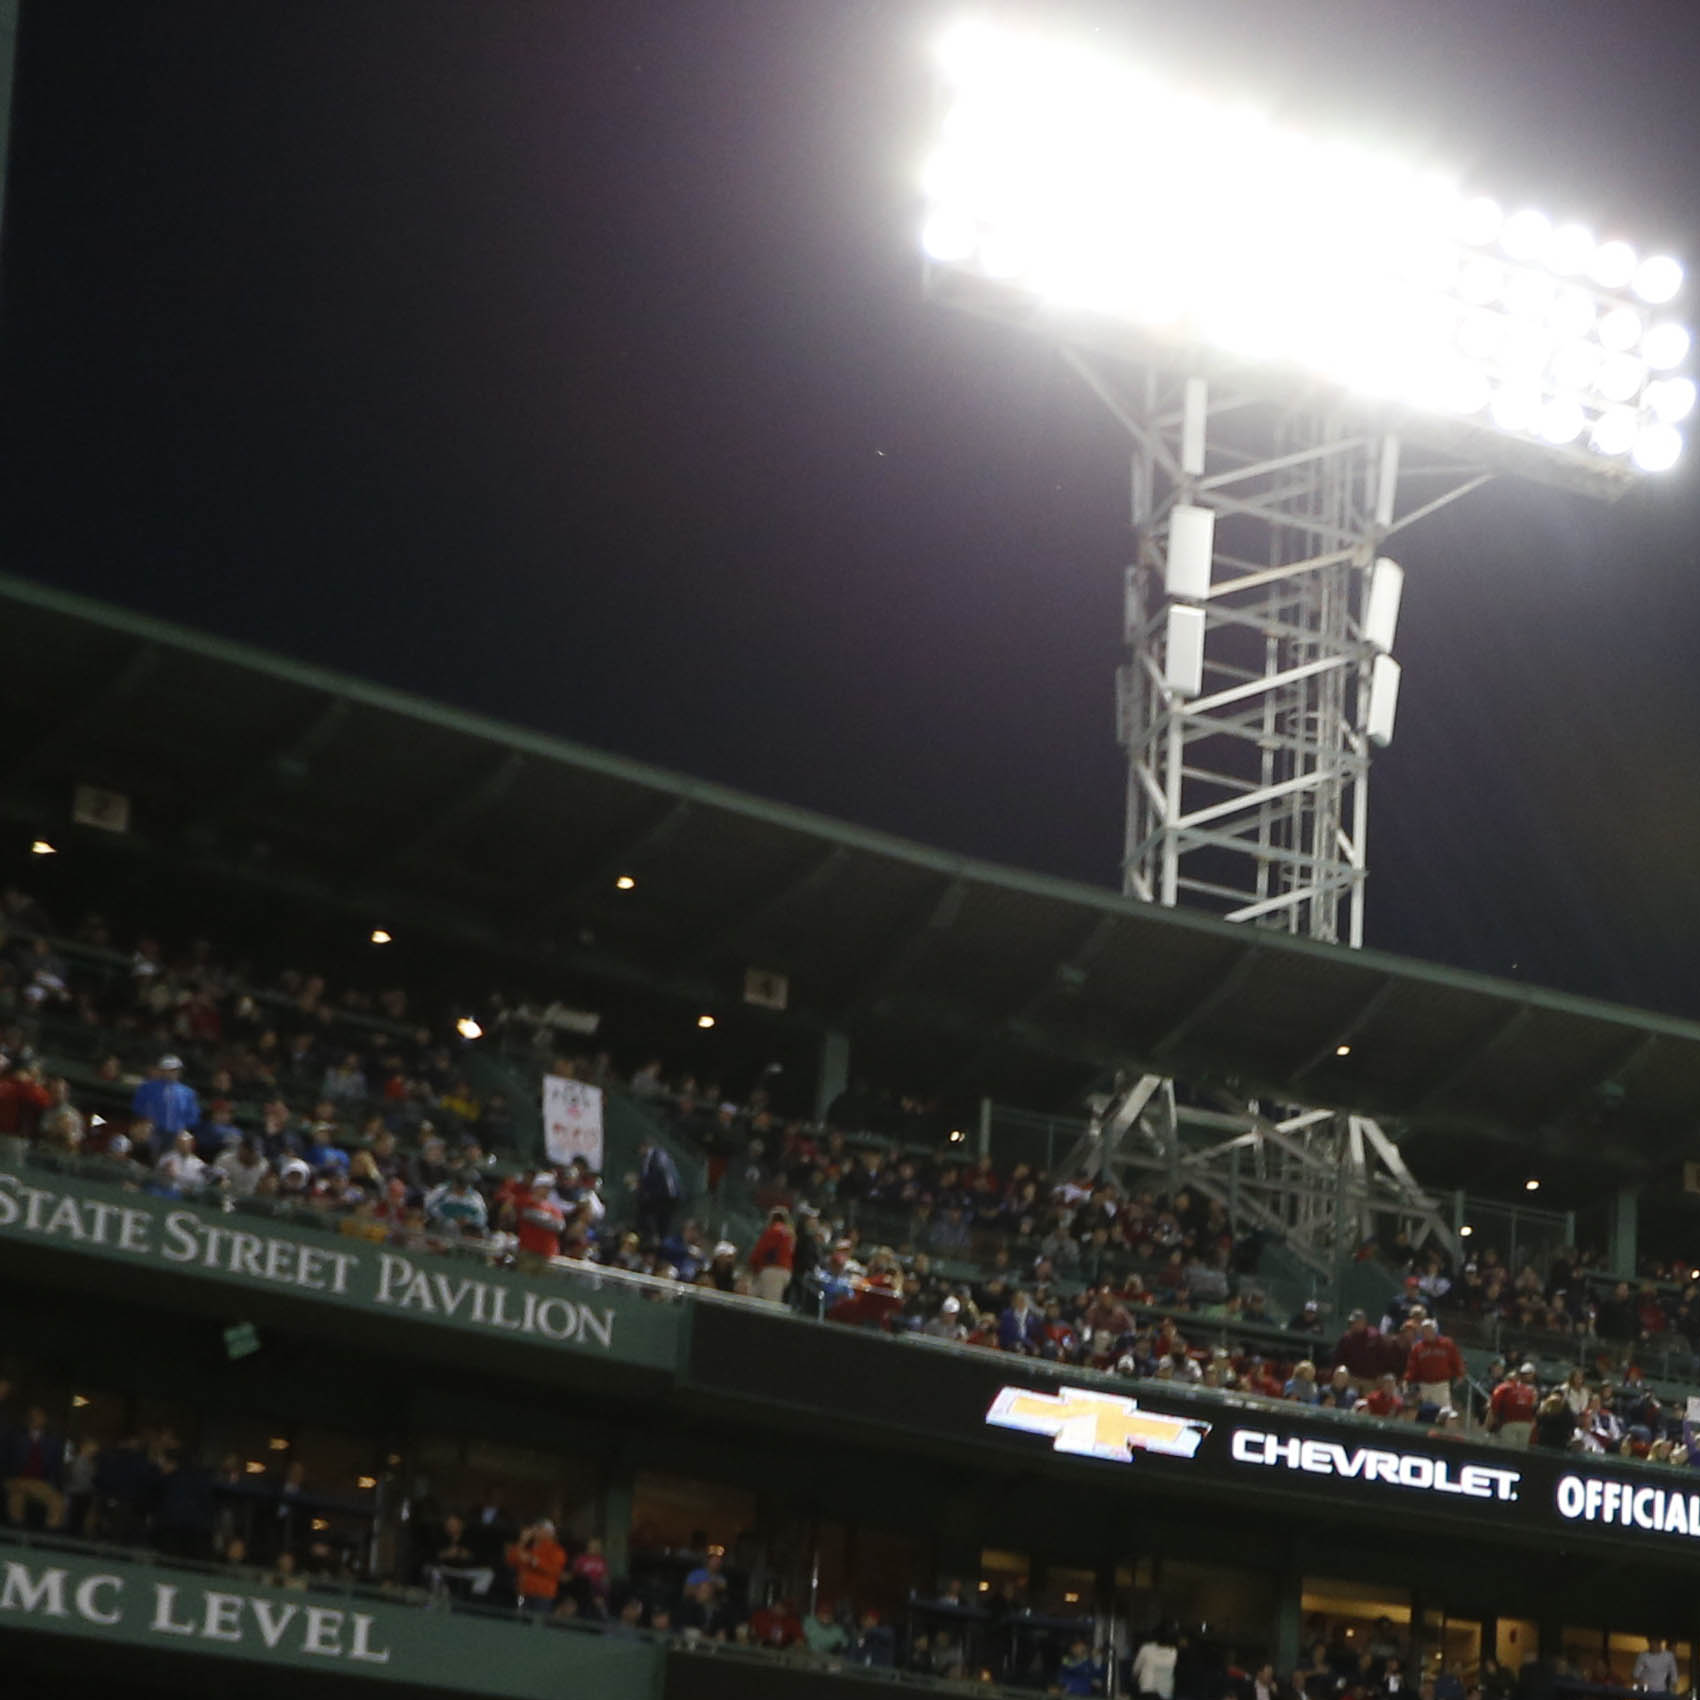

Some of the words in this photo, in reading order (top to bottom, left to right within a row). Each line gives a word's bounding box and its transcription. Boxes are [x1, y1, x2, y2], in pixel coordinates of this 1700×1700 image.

[0, 1173, 151, 1253] STATE
[161, 1209, 358, 1295] STREET
[378, 1254, 617, 1349] PAVILION
[1231, 1429, 1521, 1501] CHEVROLET
[152, 1583, 390, 1664] LEVEL
